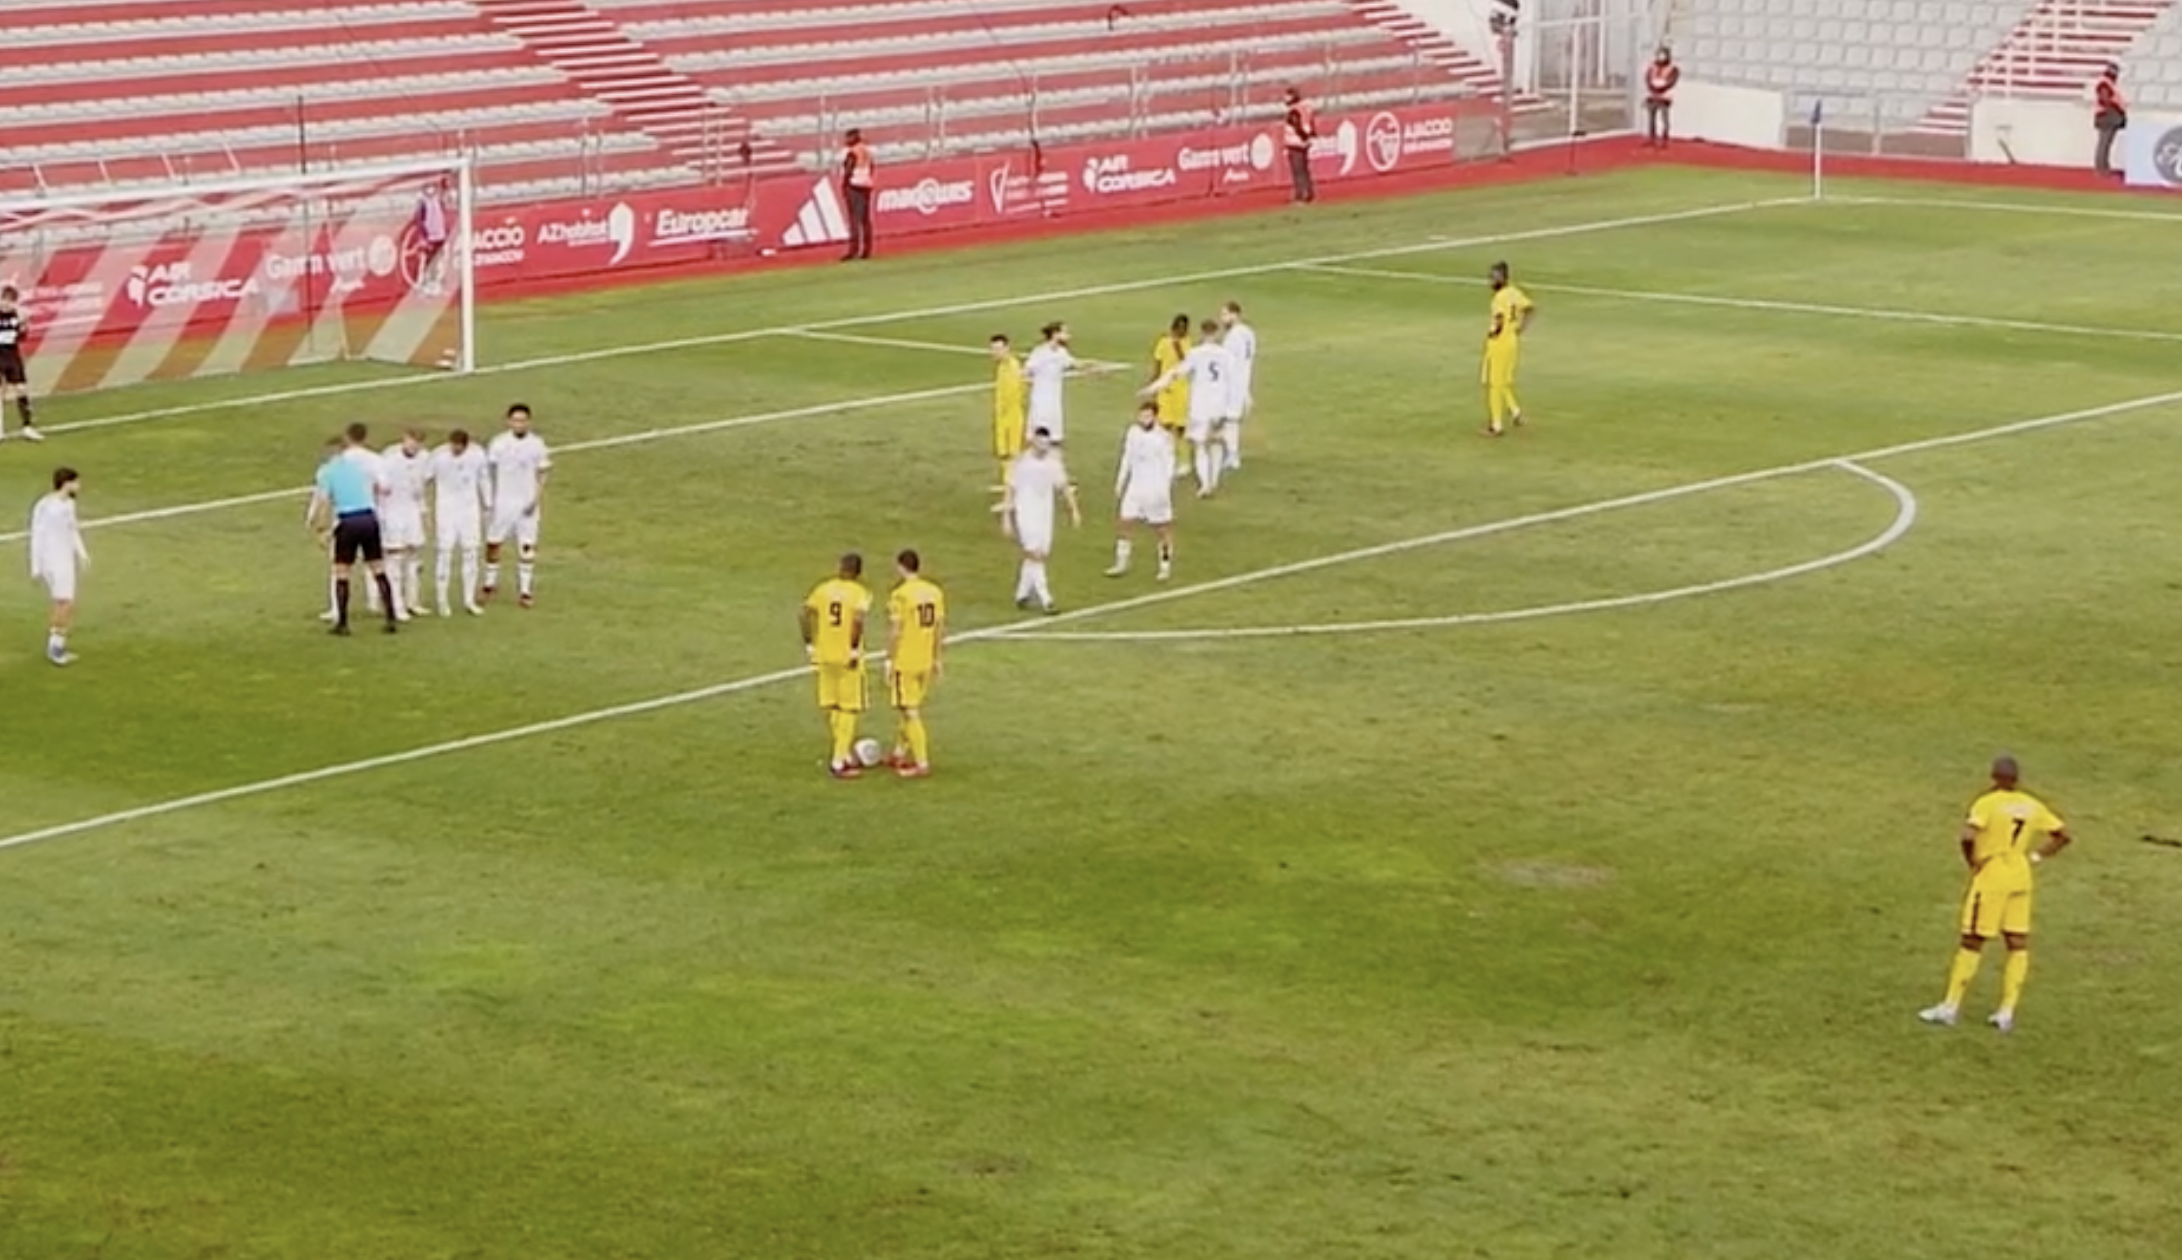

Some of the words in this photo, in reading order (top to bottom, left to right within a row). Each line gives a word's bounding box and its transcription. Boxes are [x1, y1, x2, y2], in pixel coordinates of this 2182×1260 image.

[829, 601, 842, 627] 9
[916, 603, 935, 628] 10
[2011, 818, 2025, 848] 7
